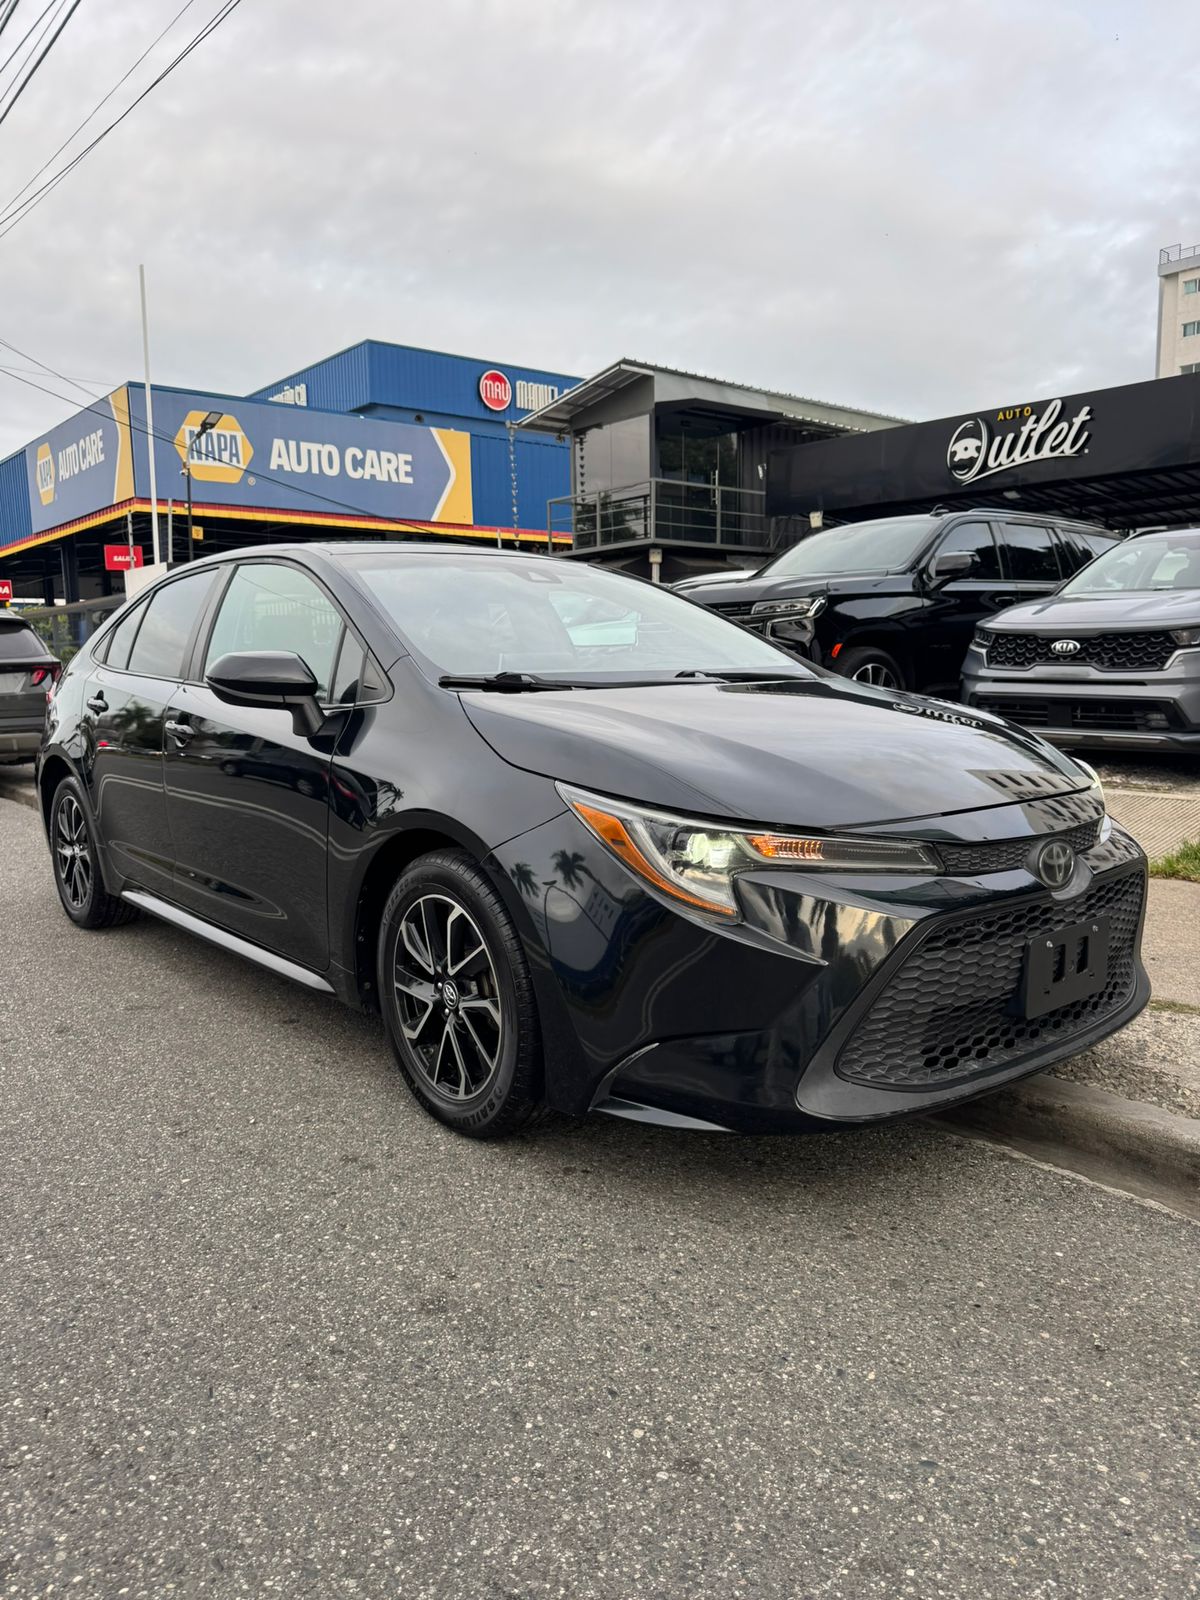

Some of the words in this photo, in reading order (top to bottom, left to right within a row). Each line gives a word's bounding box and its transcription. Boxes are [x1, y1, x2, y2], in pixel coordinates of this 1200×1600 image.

[997, 406, 1032, 421] AUTO
[58, 442, 80, 482] AUTO
[79, 428, 105, 471] CARE
[188, 429, 241, 465] NAPA
[269, 438, 341, 477] AUTO
[344, 447, 414, 484] CARE
